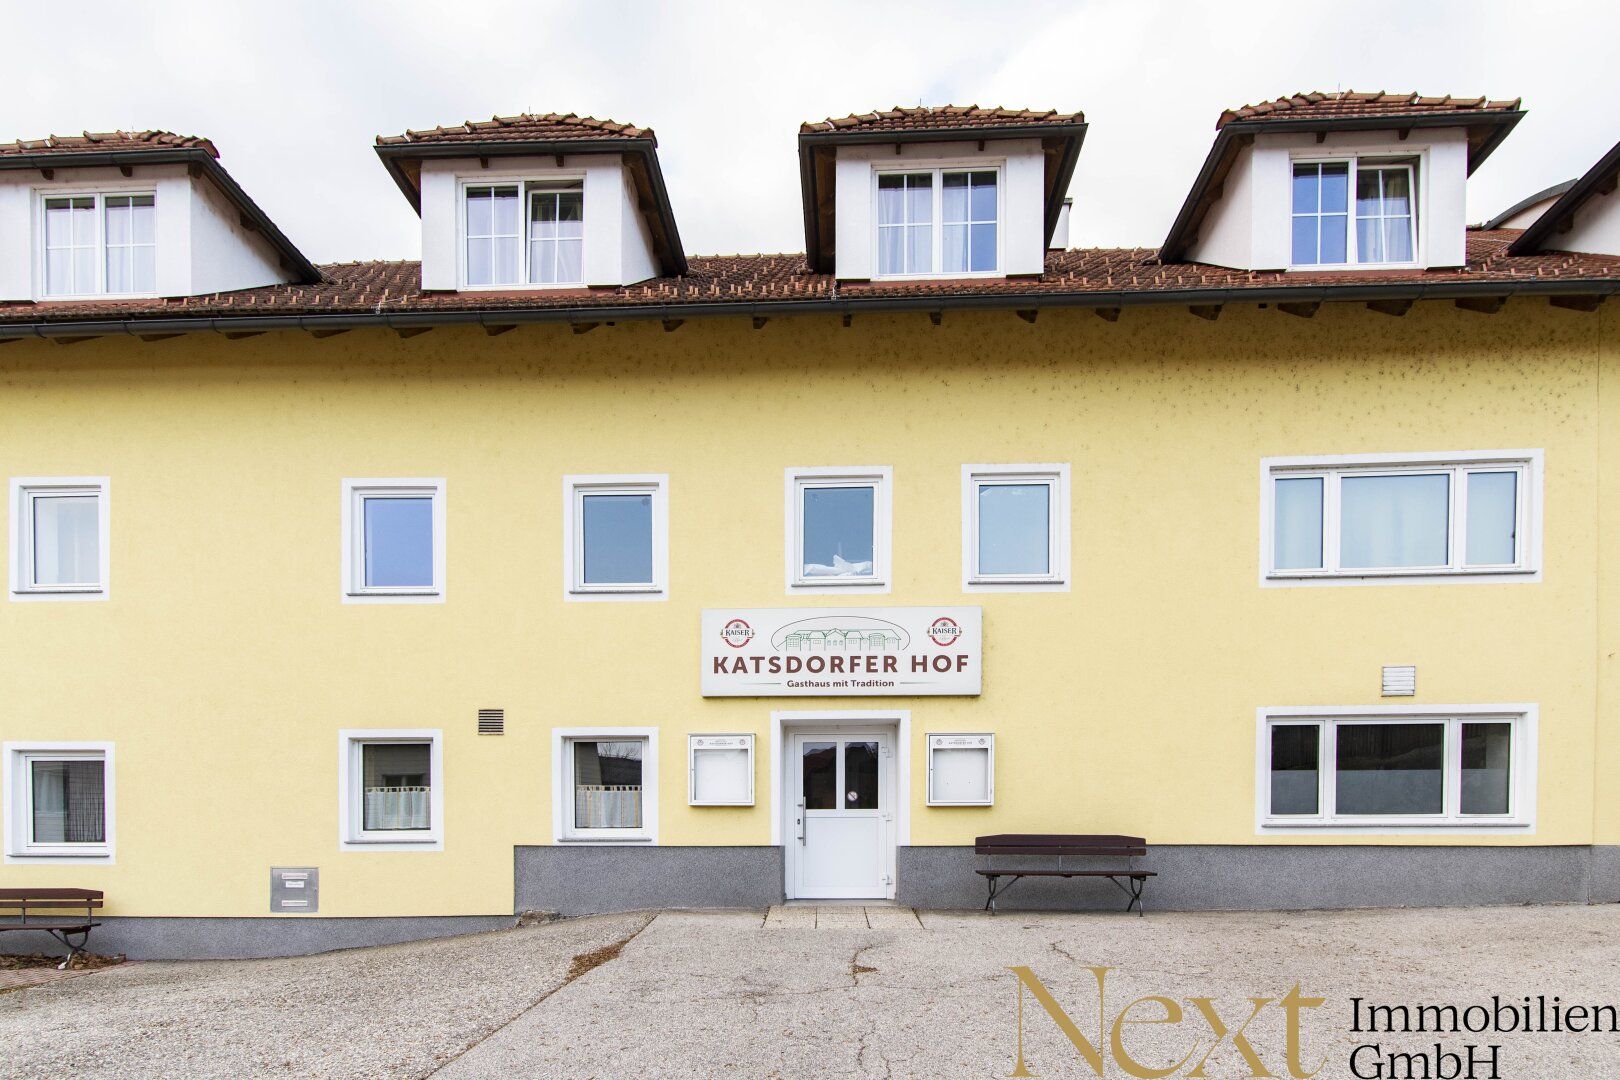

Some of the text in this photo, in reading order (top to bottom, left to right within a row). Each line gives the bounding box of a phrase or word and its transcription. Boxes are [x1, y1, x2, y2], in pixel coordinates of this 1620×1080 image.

[932, 627, 957, 635] KAISER
[713, 654, 969, 674] KATSDORFER HOF
[787, 679, 895, 688] Gasthaus mit Tradition
